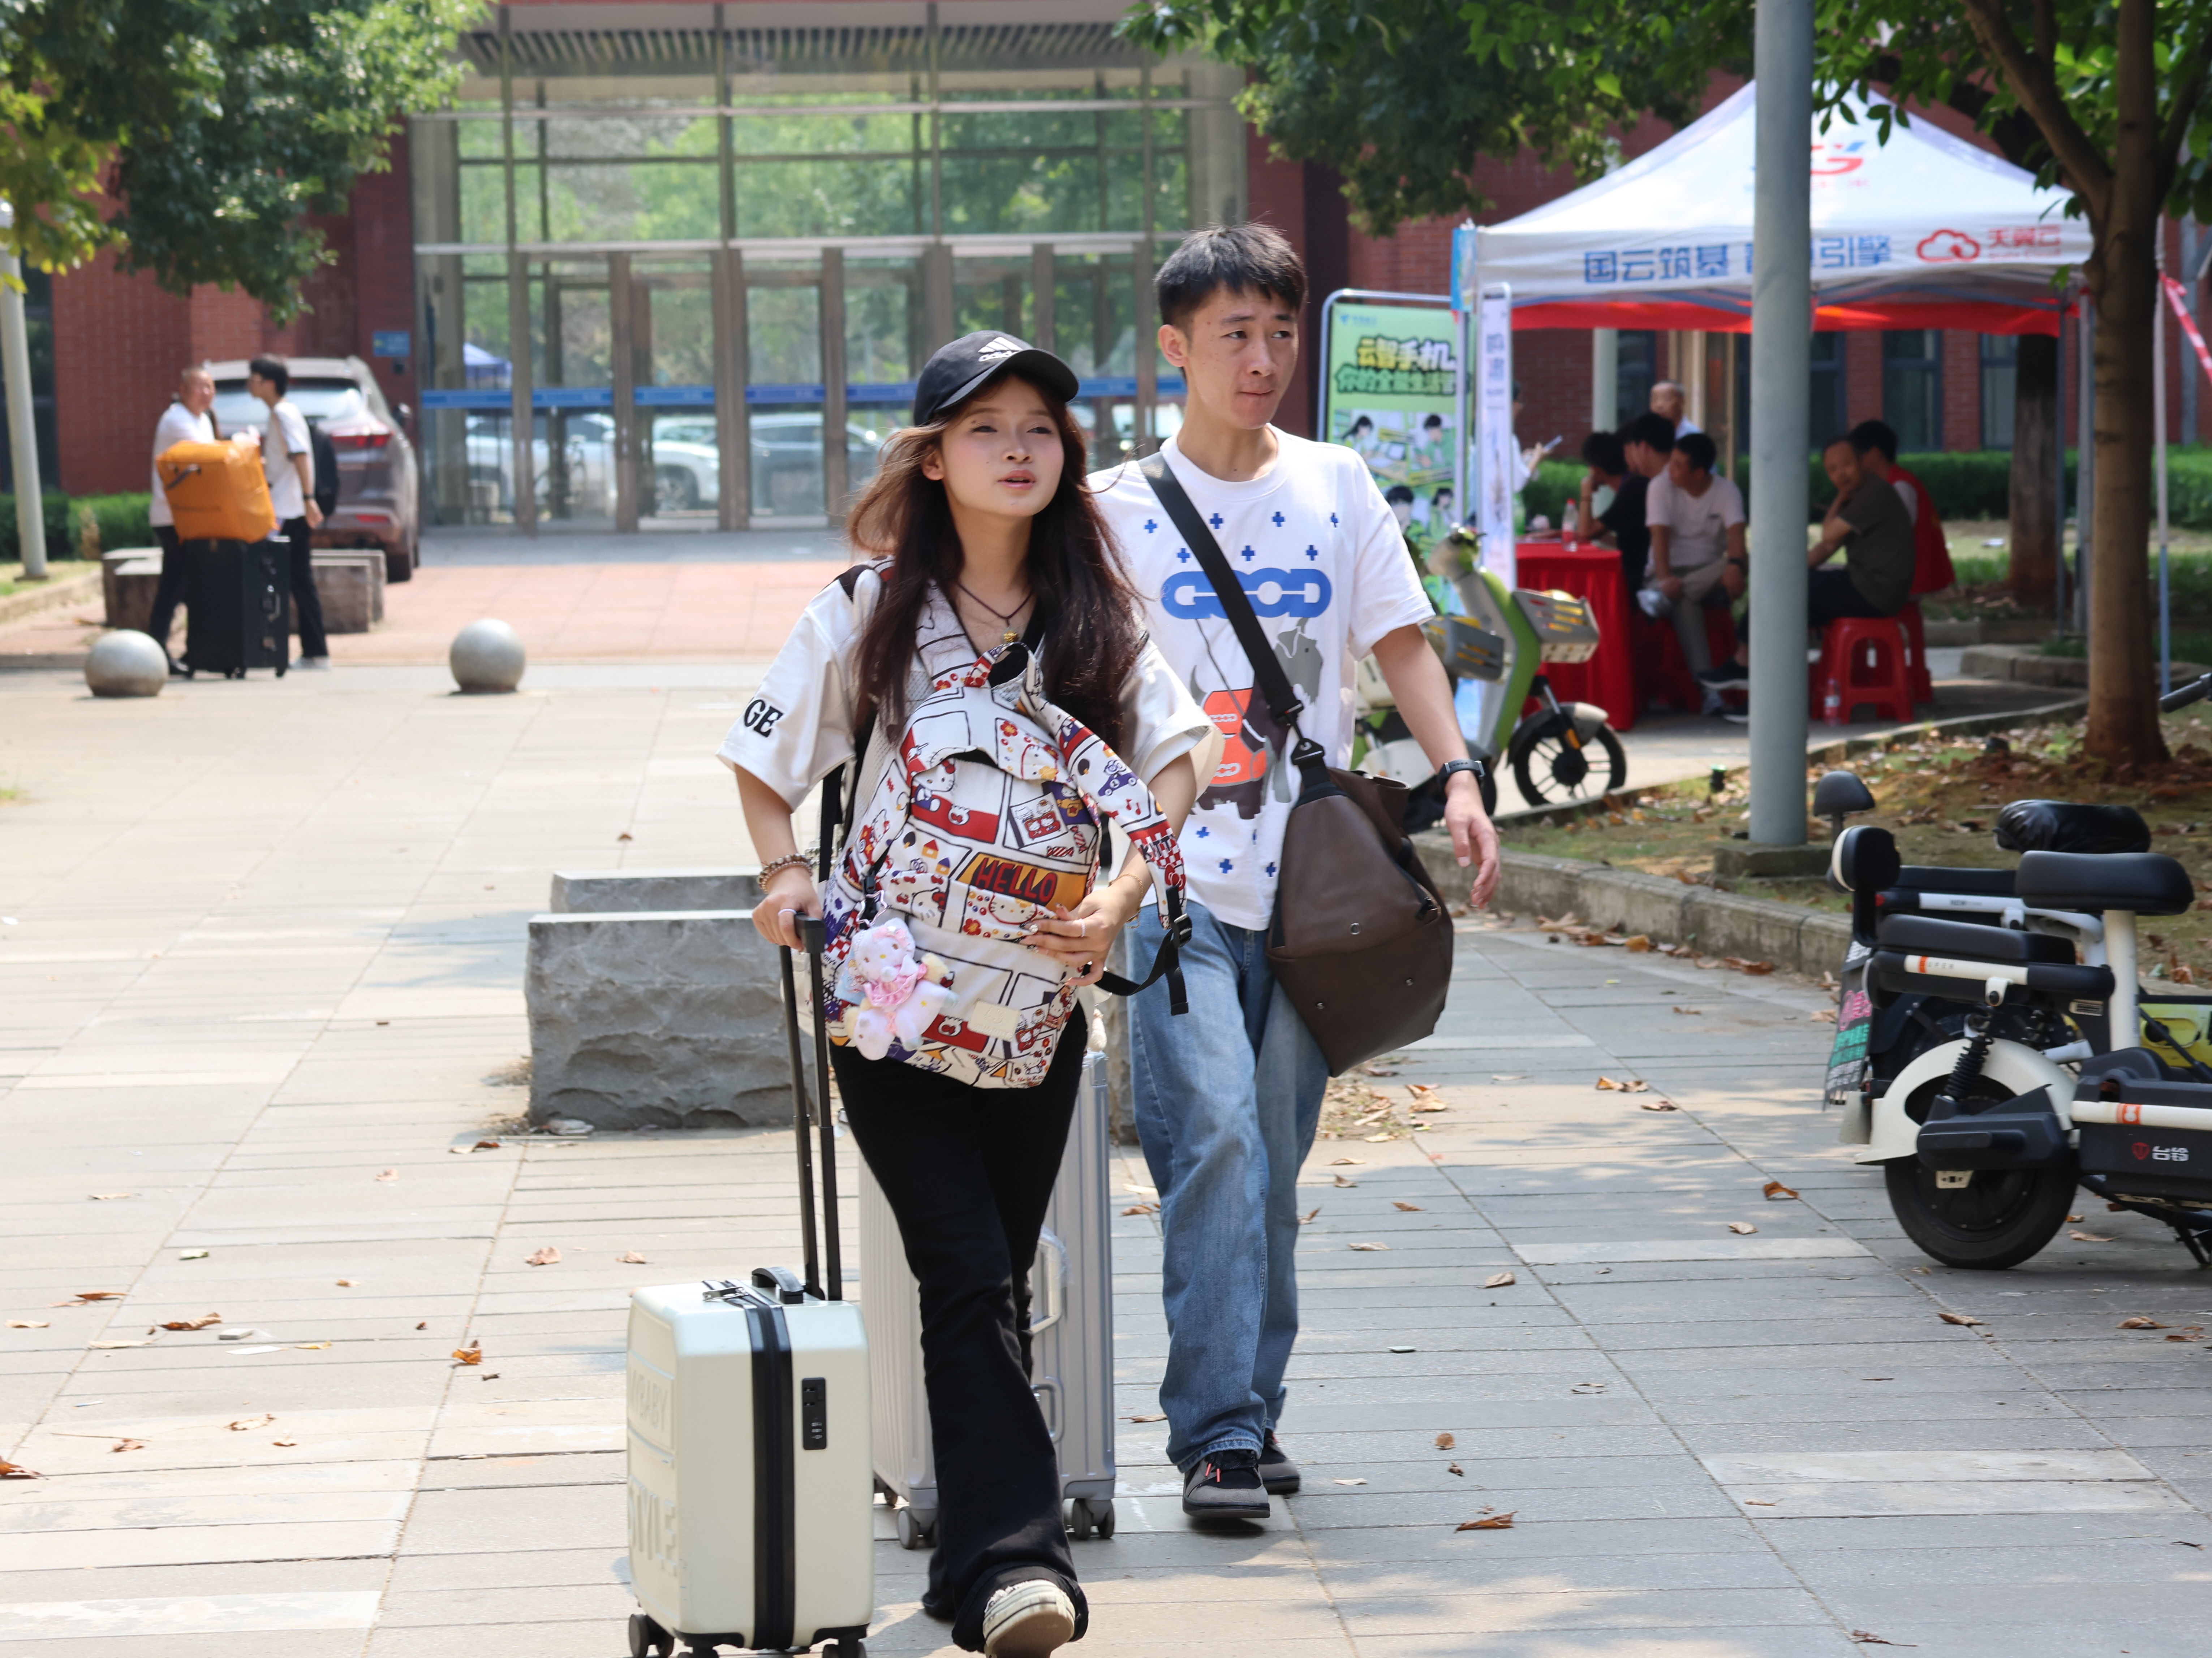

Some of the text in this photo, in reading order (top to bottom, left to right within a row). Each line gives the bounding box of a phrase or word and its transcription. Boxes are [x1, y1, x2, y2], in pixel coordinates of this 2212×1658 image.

[1988, 224, 2061, 249] 天翼云
[1585, 244, 1729, 283] 国云筑基
[1140, 834, 1176, 860] KITT
[975, 857, 1058, 903] HELLO
[2152, 1146, 2189, 1162] 台铃
